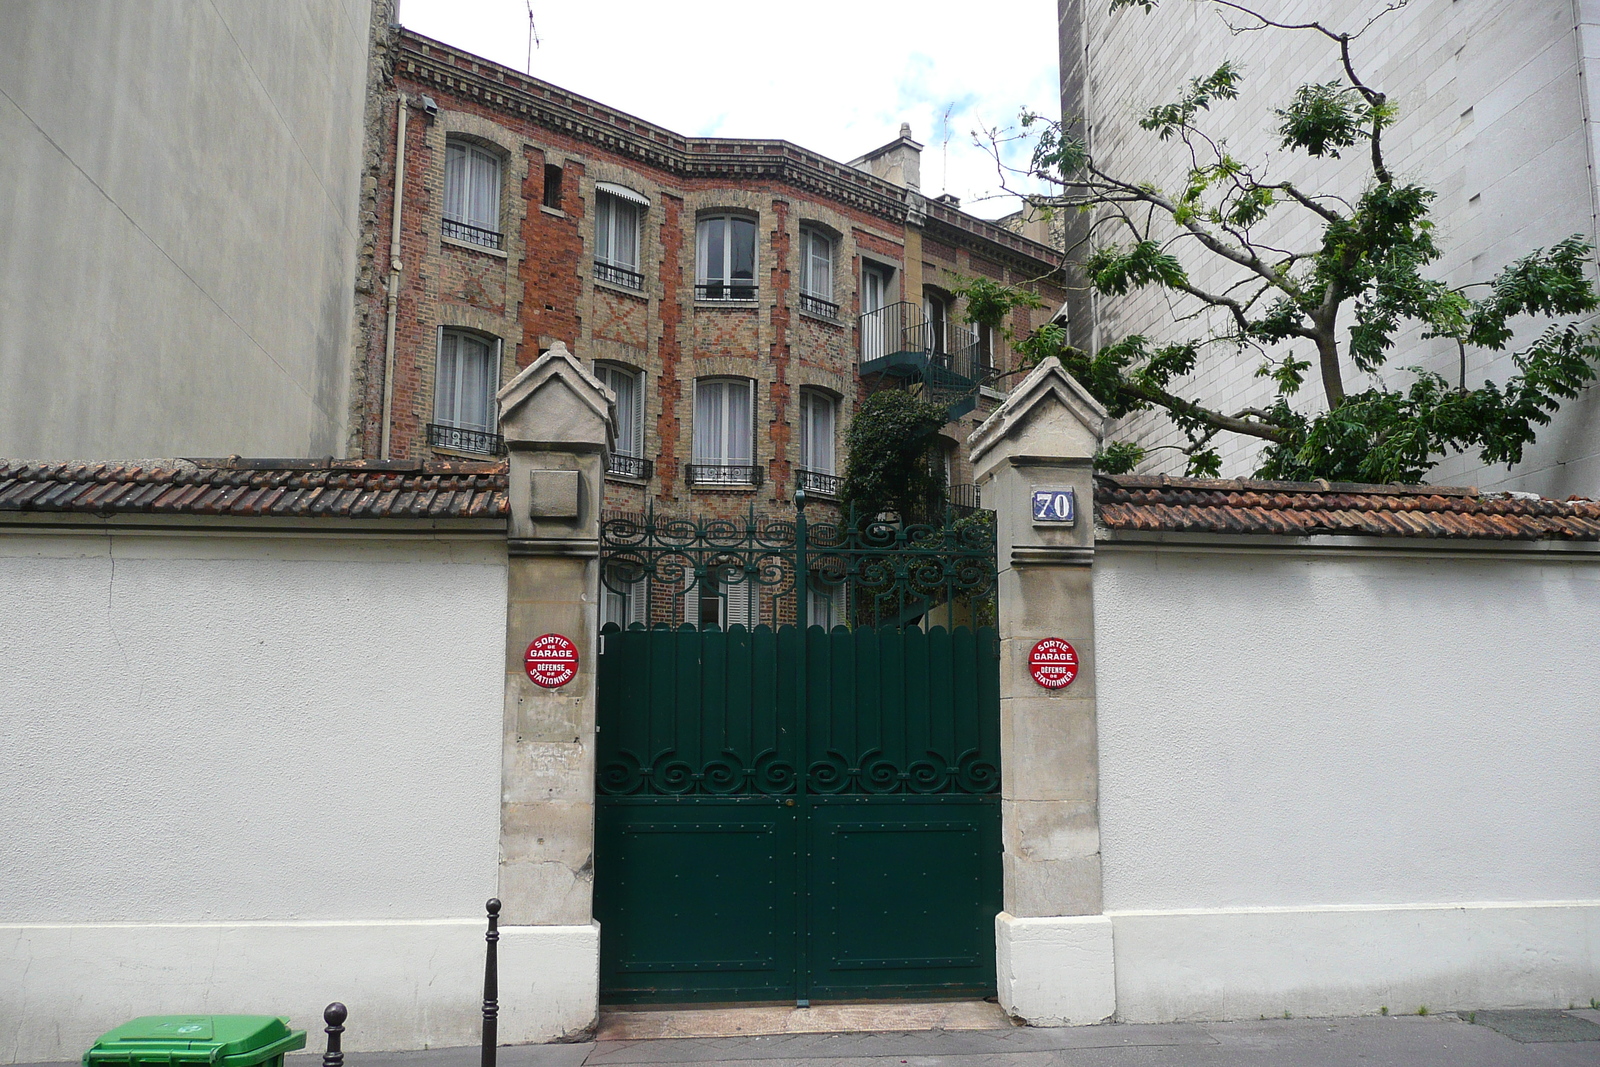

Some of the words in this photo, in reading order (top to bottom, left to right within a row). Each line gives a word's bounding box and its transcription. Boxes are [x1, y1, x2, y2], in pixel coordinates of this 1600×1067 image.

[1037, 494, 1069, 517] 70
[535, 637, 569, 648] SORTIE
[1038, 640, 1069, 652] SORTIE
[537, 663, 565, 671] DÉFENSE
[530, 669, 572, 684] STATIONNER
[1034, 671, 1073, 686] STATIONNER
